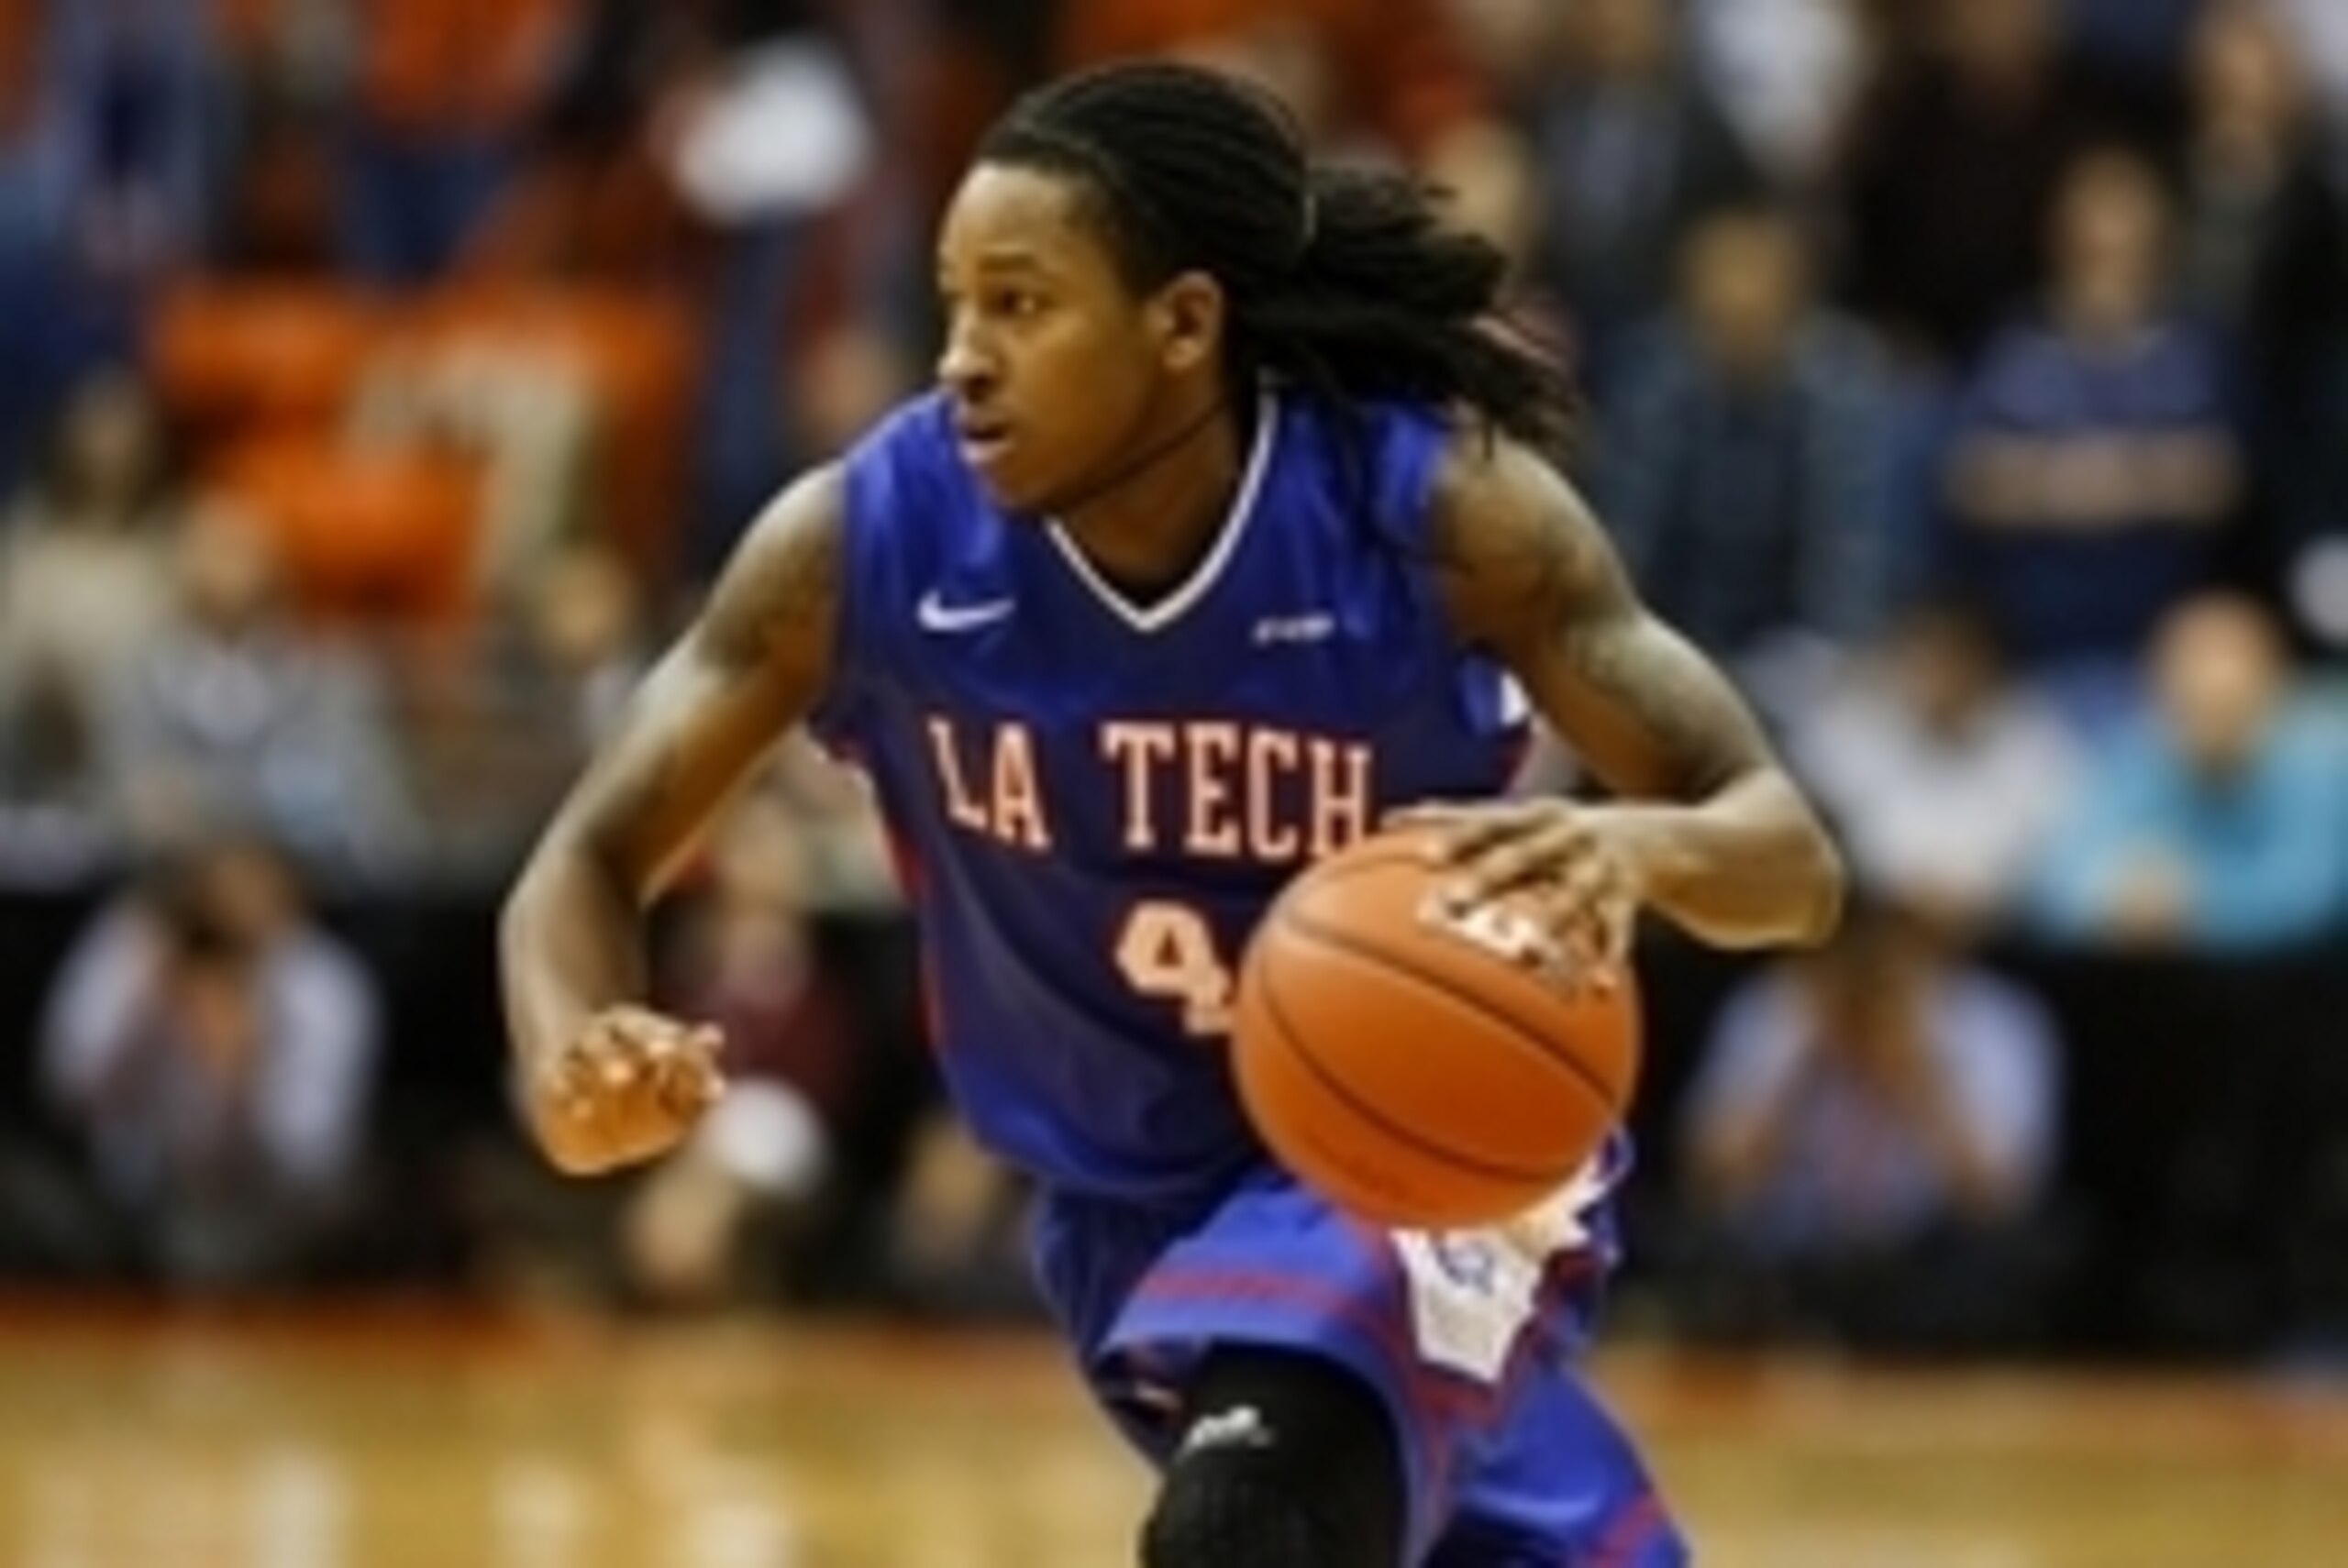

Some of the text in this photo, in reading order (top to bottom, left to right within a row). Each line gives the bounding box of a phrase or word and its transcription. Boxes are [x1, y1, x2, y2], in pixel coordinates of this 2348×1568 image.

[926, 715, 1373, 860] LA TECH
[1113, 900, 1234, 1036] 4
